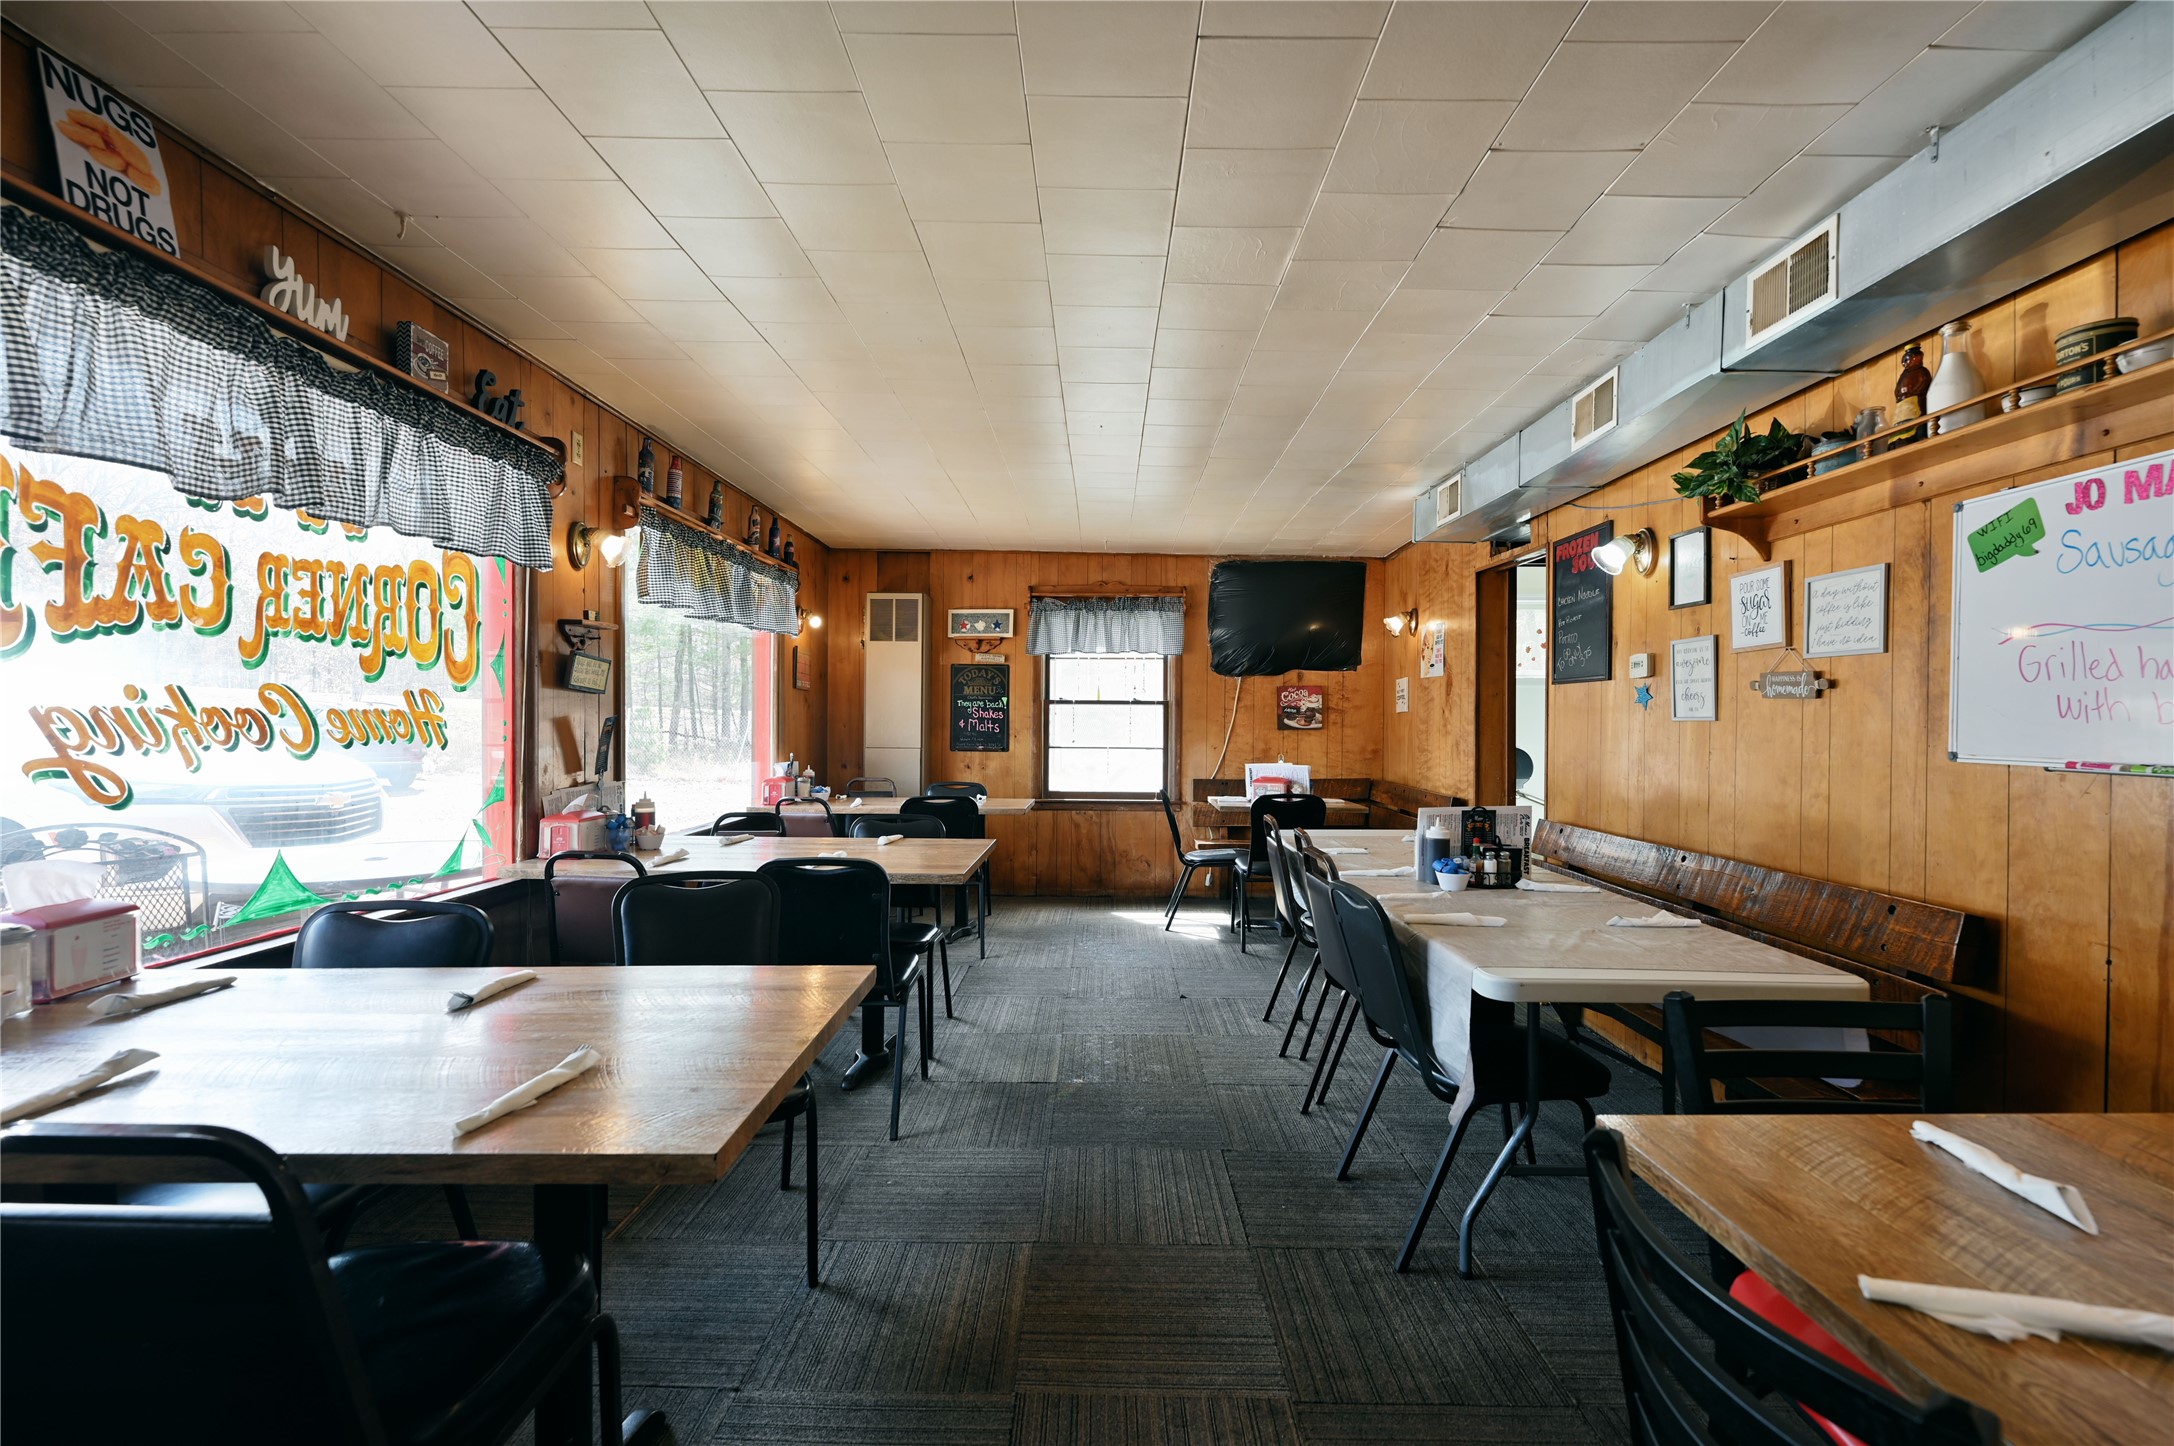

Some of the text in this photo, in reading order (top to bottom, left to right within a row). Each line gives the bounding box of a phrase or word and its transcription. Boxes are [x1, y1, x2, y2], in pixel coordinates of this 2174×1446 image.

[40, 51, 157, 149] NUGS
[84, 160, 150, 217] NOT
[65, 179, 177, 257] DRUGS
[424, 340, 445, 361] COFFEE
[2065, 458, 2174, 515] JO M
[1976, 509, 2014, 537] WIFI
[1556, 531, 1599, 563] FROZEN
[1571, 553, 1595, 574] SOU
[1740, 577, 1770, 594] POUR SOME
[1841, 579, 1879, 595] without
[1739, 589, 1771, 620] sugar
[1816, 602, 1841, 616] coffee
[1742, 614, 1751, 628] ON
[1834, 616, 1872, 631] kidding
[1816, 635, 1838, 647] have
[1853, 633, 1877, 643] idea
[1675, 656, 1710, 677] awesome
[2018, 640, 2125, 683] Grilled
[958, 669, 1002, 685] TODAY'S
[1763, 672, 1815, 698] homemade
[963, 686, 996, 695] MENU
[1281, 689, 1308, 702] Cocoa
[1681, 686, 1706, 709] cheers
[957, 700, 972, 713] They
[972, 707, 1004, 718] Shakes
[968, 719, 1000, 732] Malts
